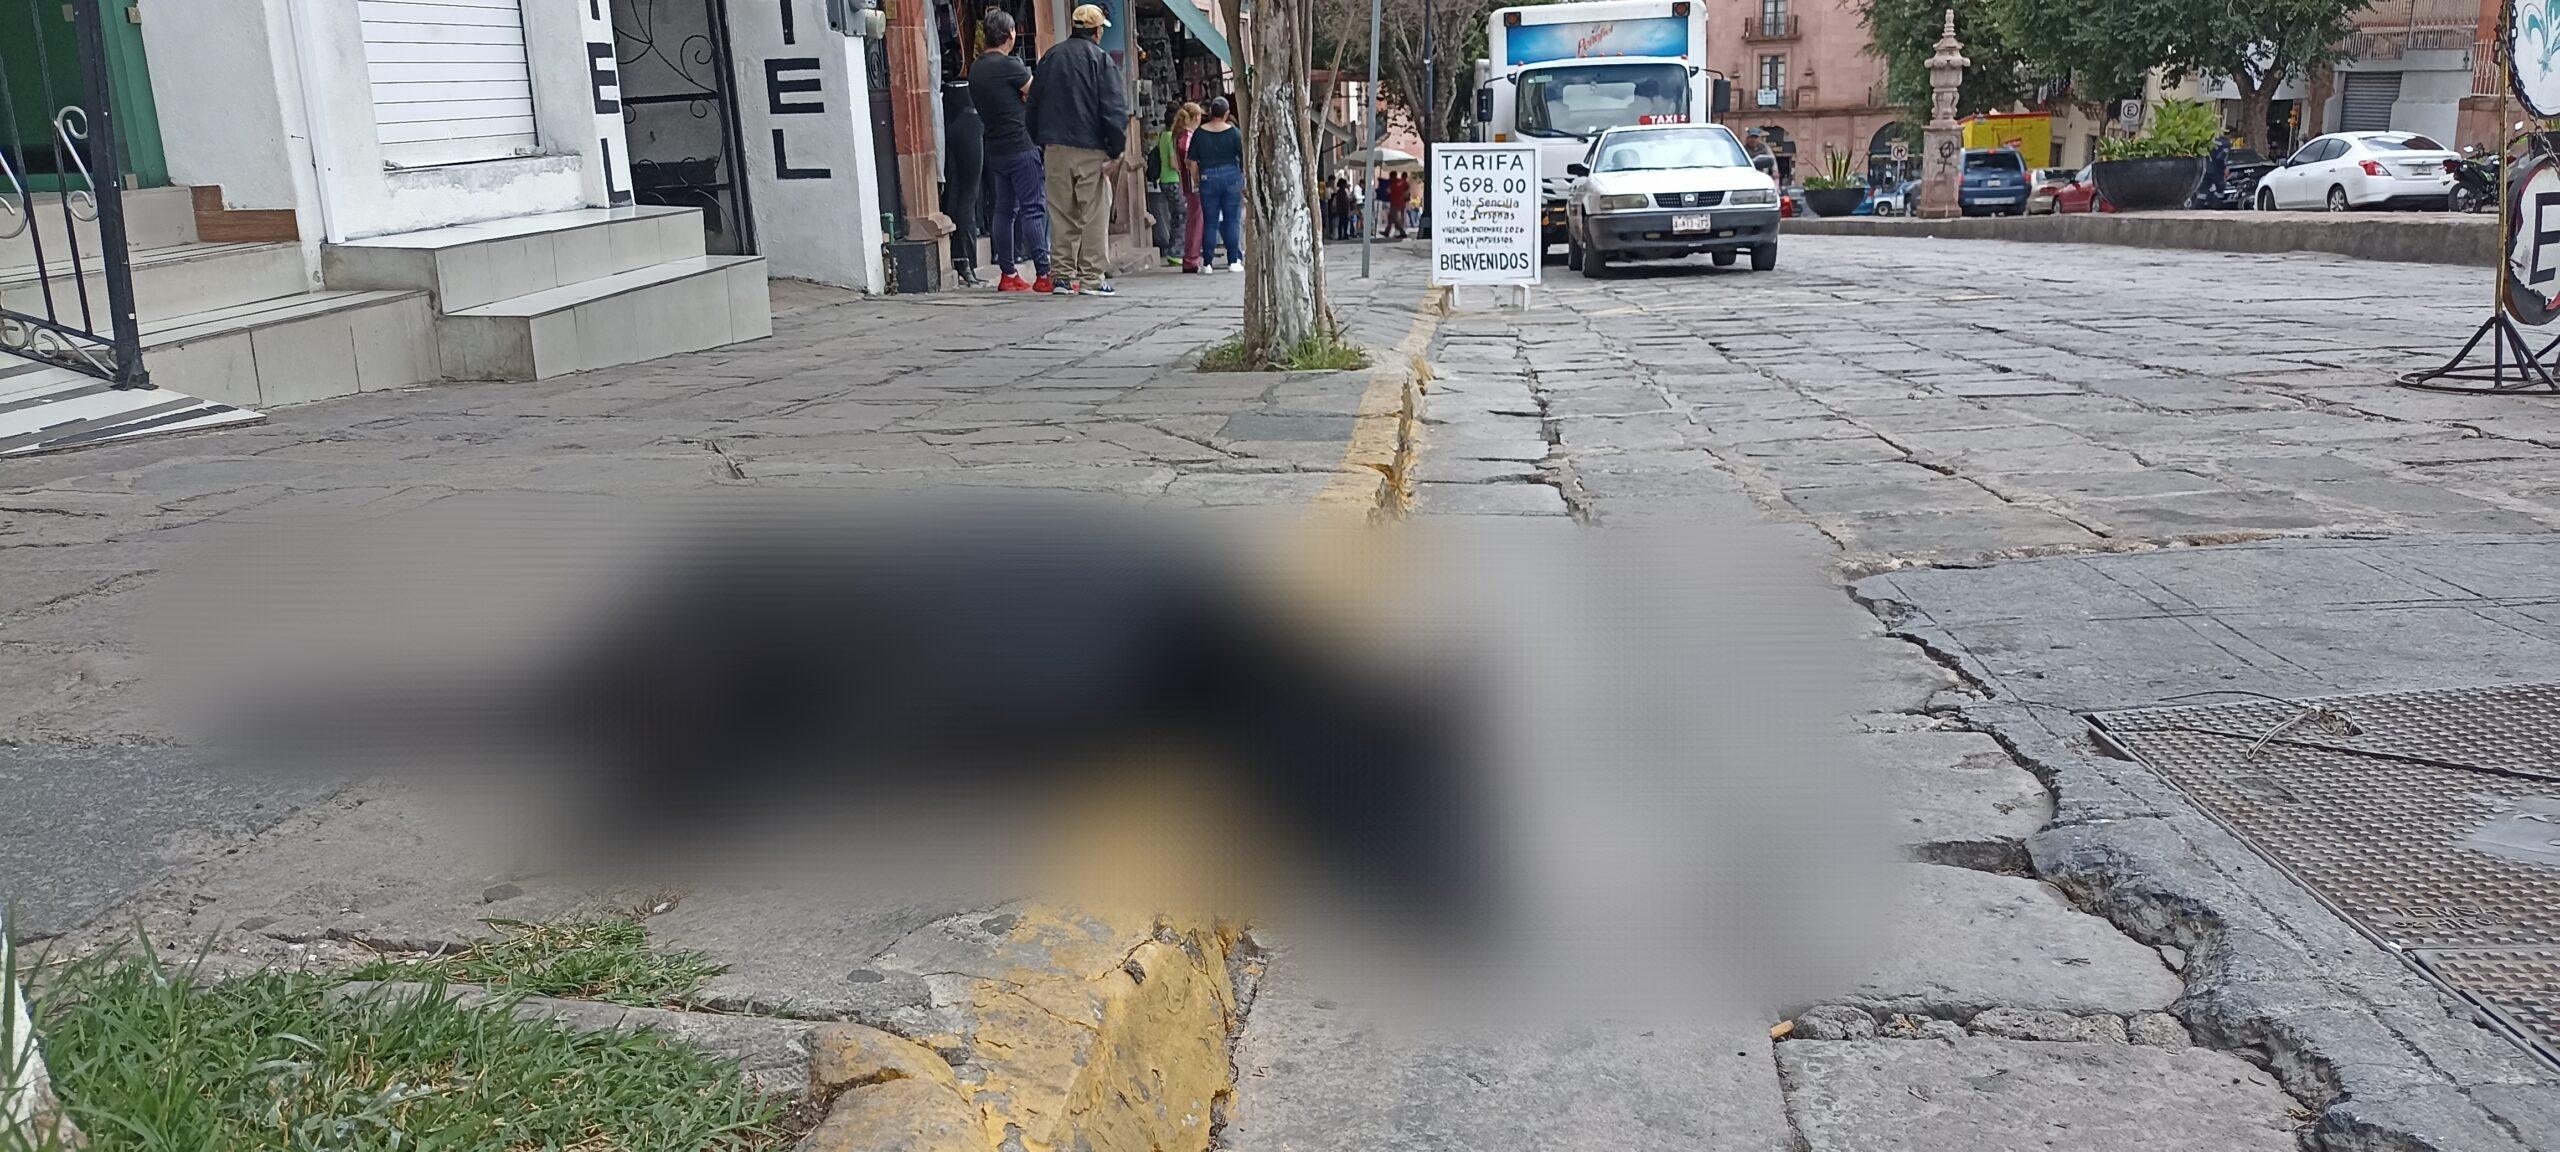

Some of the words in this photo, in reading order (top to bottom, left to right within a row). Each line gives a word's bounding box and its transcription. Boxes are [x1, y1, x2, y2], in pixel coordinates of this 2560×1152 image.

[1649, 114, 1678, 124] TAXI
[1441, 154, 1524, 171] TARIFA
[1478, 197, 1519, 208] Sencilla
[1442, 226, 1470, 234] VIGENCIA
[1445, 236, 1474, 247] INCLUYE
[1475, 236, 1513, 246] IMPUESTOS
[1440, 252, 1529, 271] BIENVENIDOS
